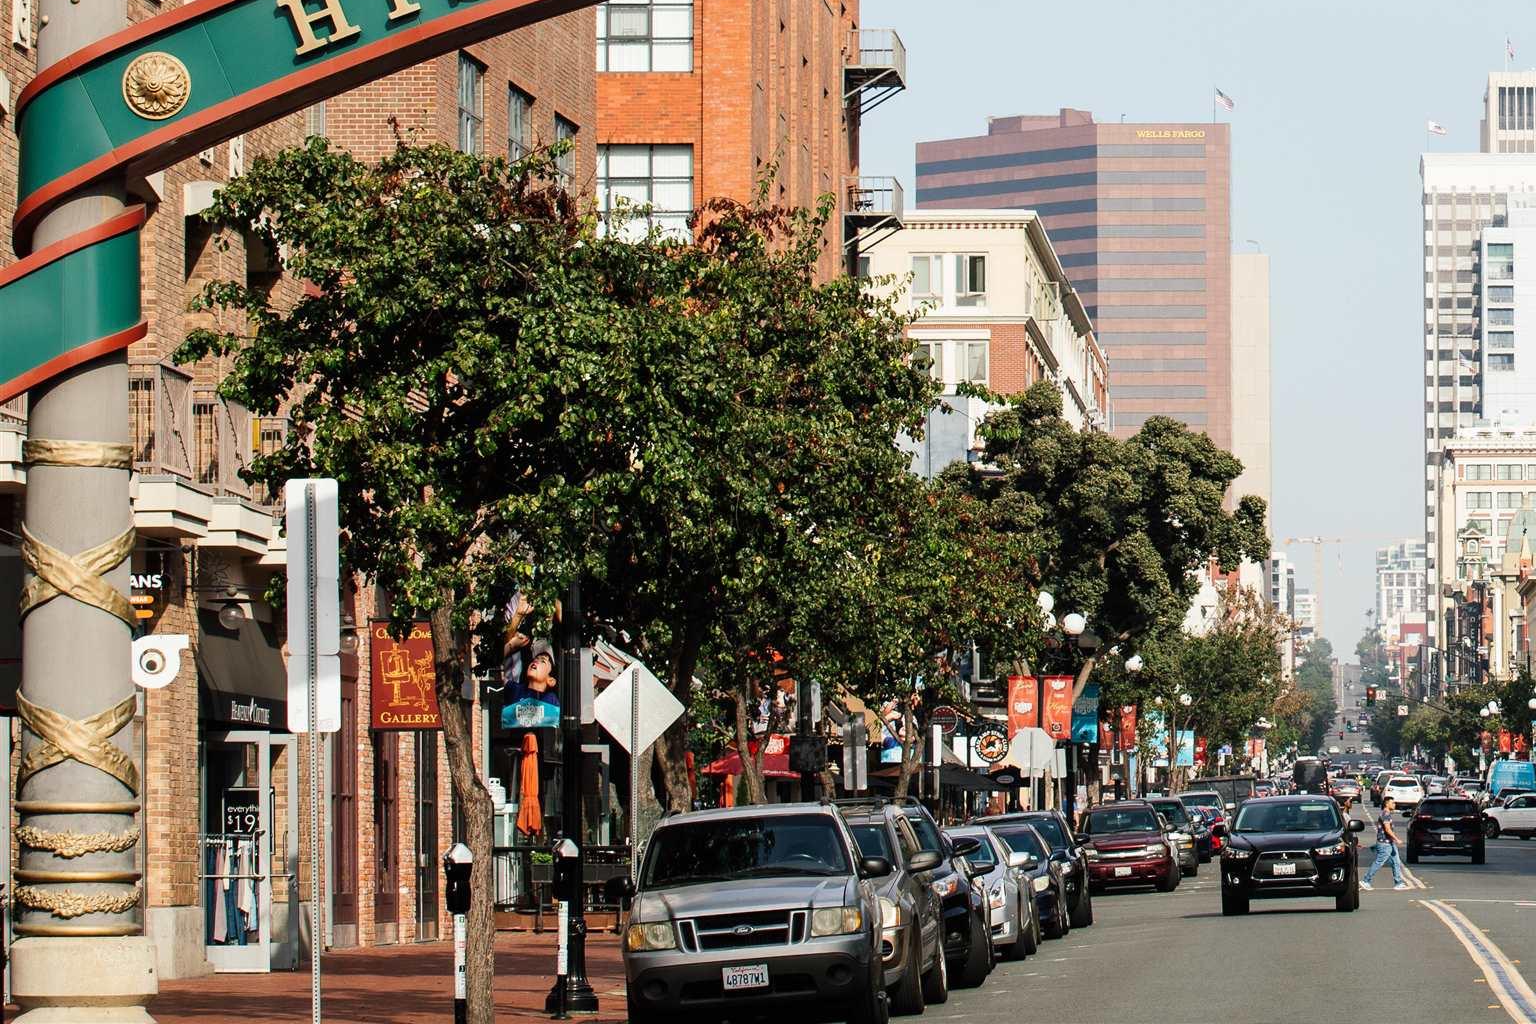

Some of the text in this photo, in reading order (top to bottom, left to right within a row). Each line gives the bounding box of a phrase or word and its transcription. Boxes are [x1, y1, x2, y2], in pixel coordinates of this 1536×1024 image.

[1136, 130, 1205, 138] WELLS FARGO
[380, 712, 438, 724] GALLERY
[227, 804, 259, 814] everythi
[227, 814, 256, 833] $19
